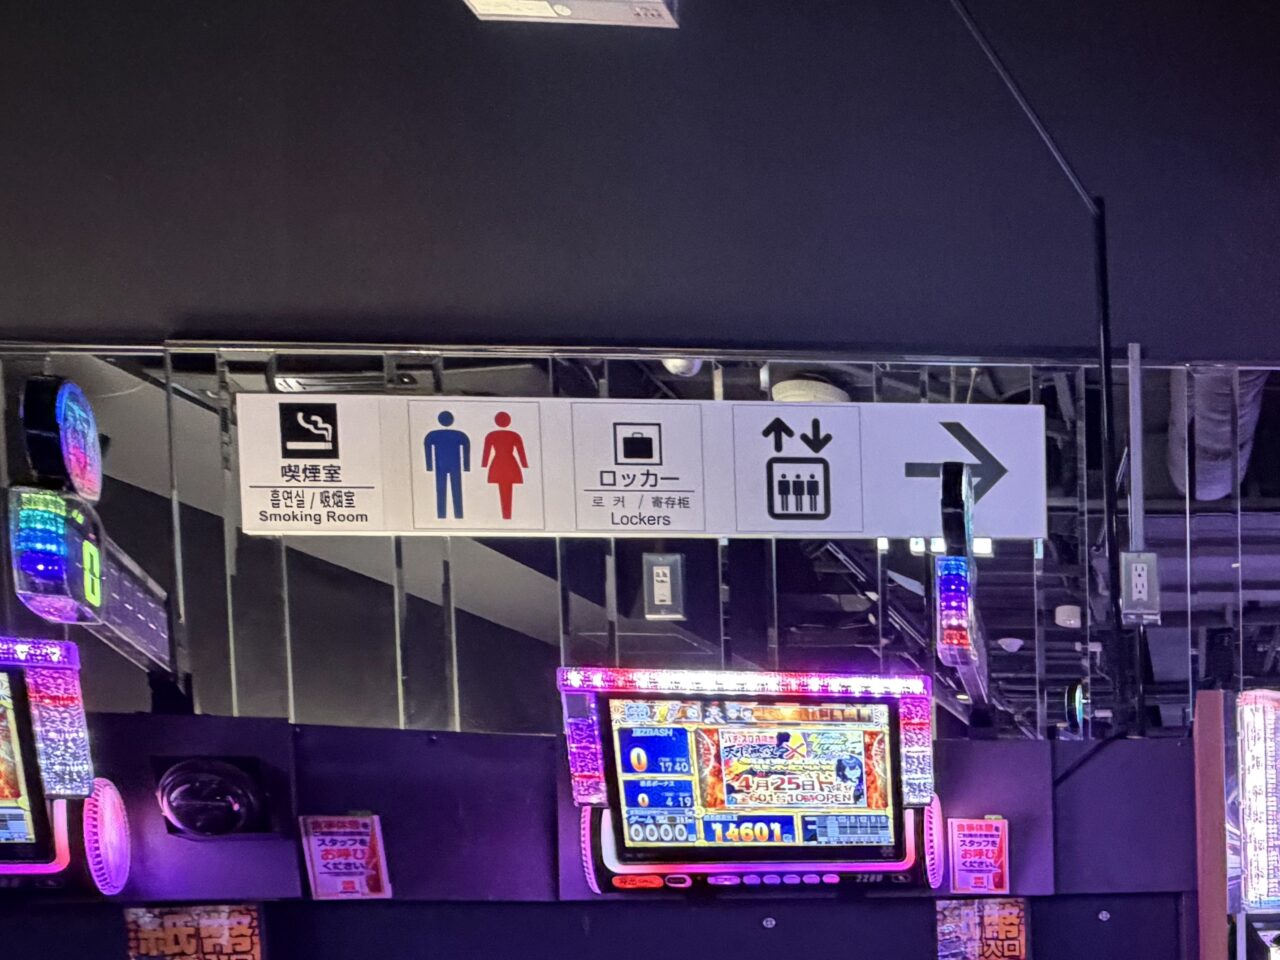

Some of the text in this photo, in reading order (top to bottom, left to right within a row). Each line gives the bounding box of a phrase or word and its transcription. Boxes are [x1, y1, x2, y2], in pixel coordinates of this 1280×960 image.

[280, 464, 342, 483] 喫煙室
[600, 471, 680, 488] ロッカー
[259, 510, 369, 526] Smoking Room
[611, 512, 671, 526] Lockers
[630, 823, 688, 841] 0000
[711, 822, 782, 842] 14601
